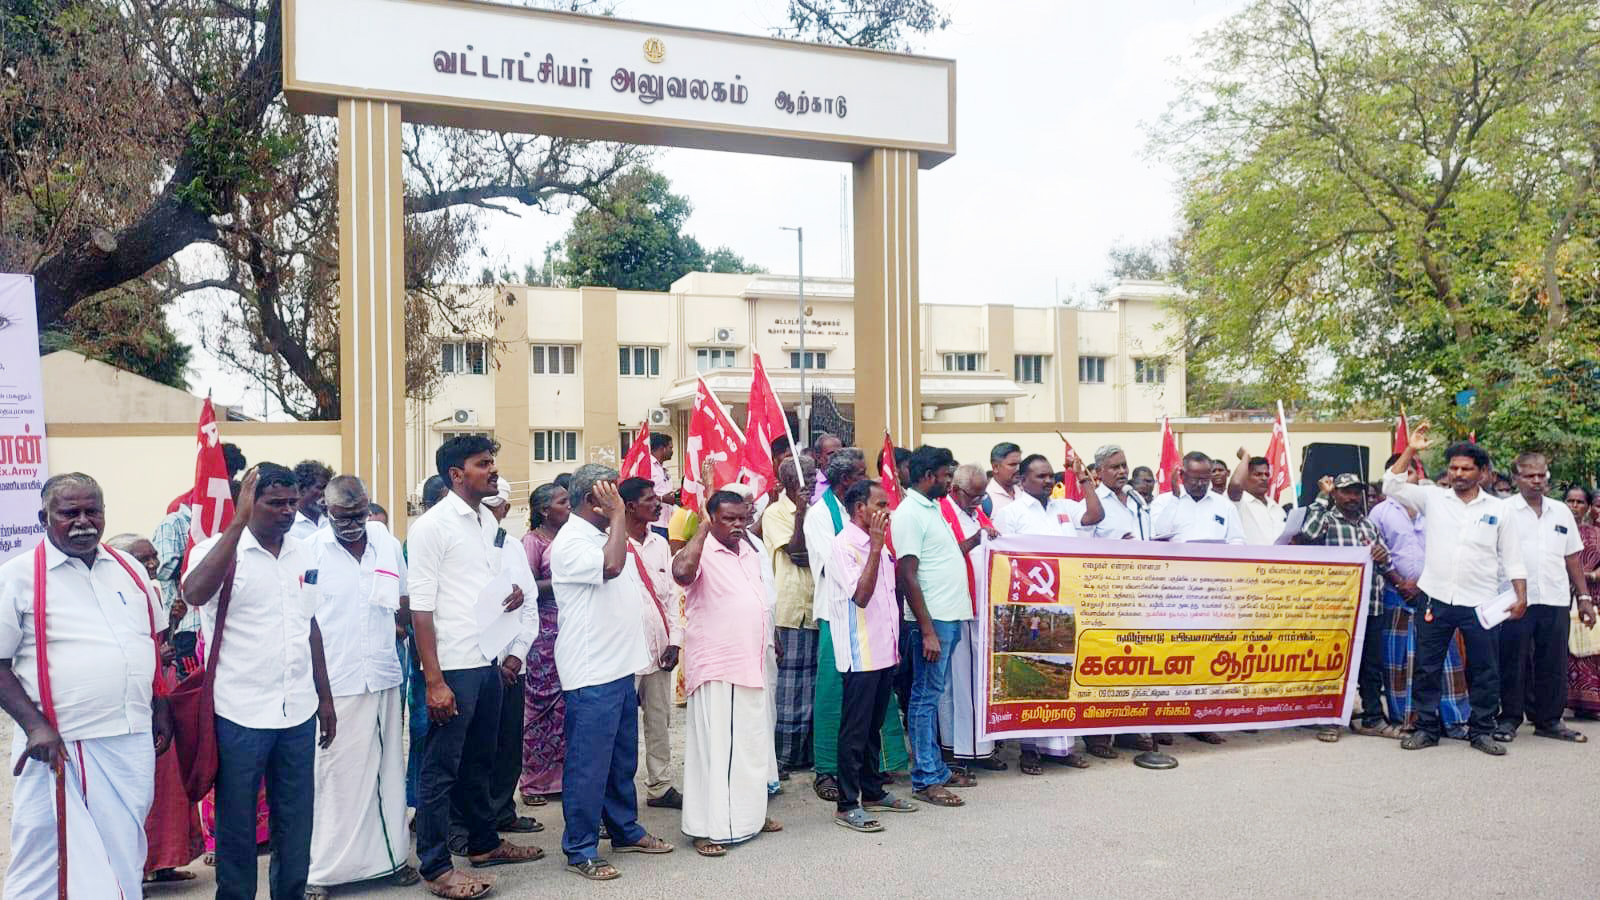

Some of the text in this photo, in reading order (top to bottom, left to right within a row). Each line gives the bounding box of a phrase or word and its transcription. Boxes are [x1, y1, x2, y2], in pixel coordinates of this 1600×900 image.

[433, 45, 847, 118] வட்டாட்சியர் அலுவலகம் ஆற்காடு
[0, 466, 38, 478] x.Army
[1080, 643, 1344, 681] கண்டன ஆர்ப்பாட்டம்
[1021, 704, 1076, 723] தமிழ்நாடு
[1083, 703, 1149, 719] விவசாயிகள்
[1155, 701, 1191, 718] சங்கம்
